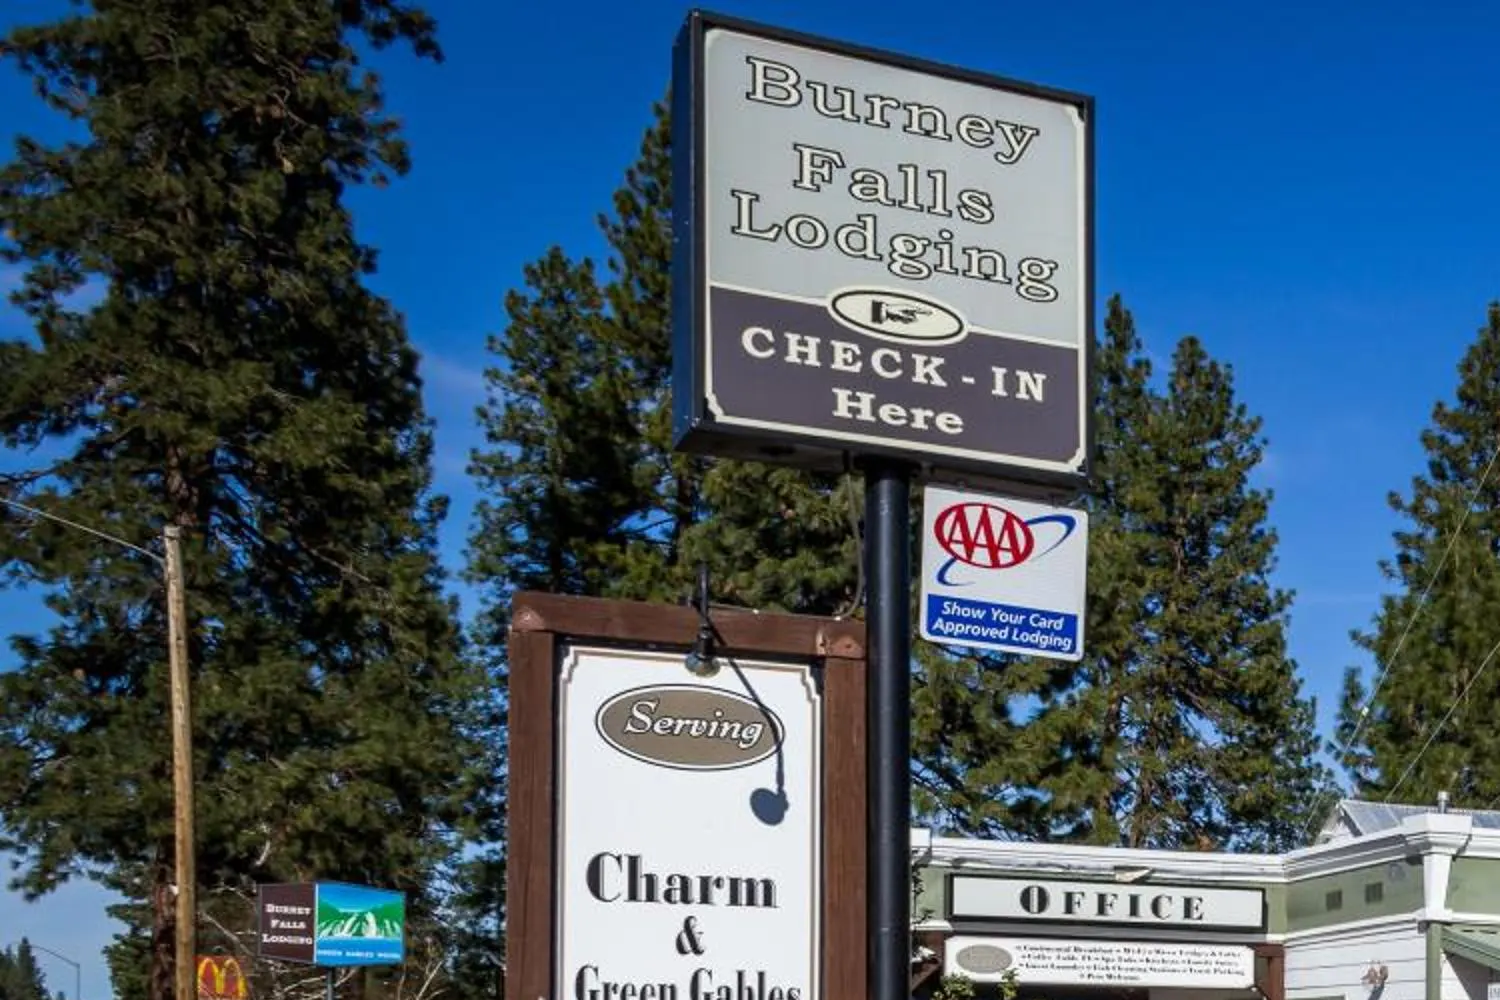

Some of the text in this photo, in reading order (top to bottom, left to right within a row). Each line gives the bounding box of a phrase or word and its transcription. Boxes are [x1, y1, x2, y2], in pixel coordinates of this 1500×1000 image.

[746, 56, 1039, 164] Burney
[794, 143, 994, 225] Falls
[731, 190, 1058, 302] Lodging
[832, 388, 963, 434] Here
[941, 503, 1028, 569] AAA
[931, 617, 1073, 650] Approved Lodging
[941, 601, 1065, 631] Show Your Card
[624, 698, 765, 749] Serving
[586, 851, 778, 909] Charm
[1019, 884, 1205, 921] OFFICE
[675, 915, 706, 956] &
